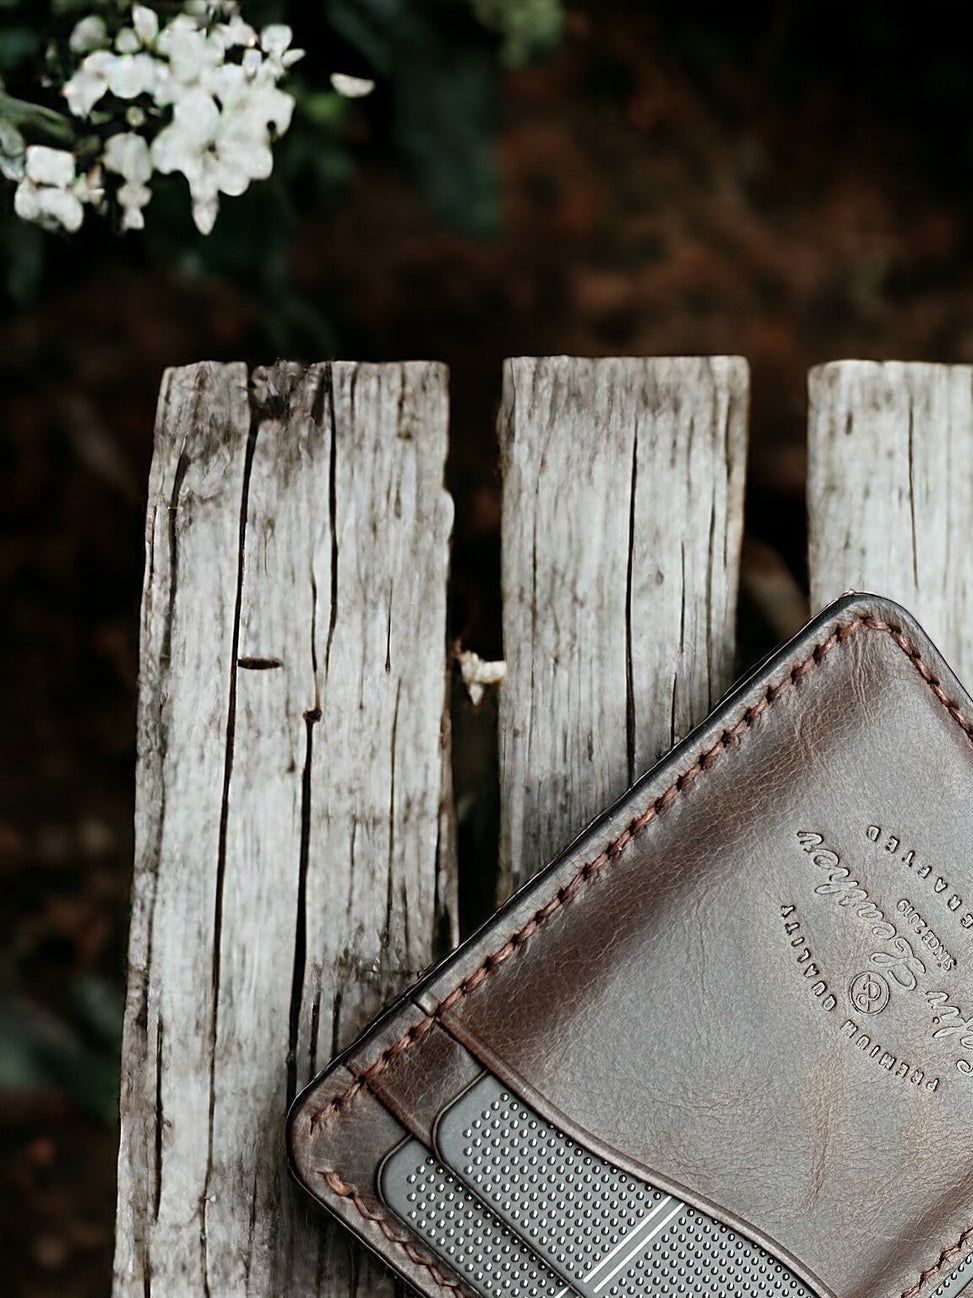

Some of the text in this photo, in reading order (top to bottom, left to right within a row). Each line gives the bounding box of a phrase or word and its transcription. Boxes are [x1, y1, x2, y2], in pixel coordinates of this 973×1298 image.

[797, 830, 926, 991] Leather
[897, 898, 928, 935] 2019
[780, 903, 940, 1092] PREMIUM QUALITY
